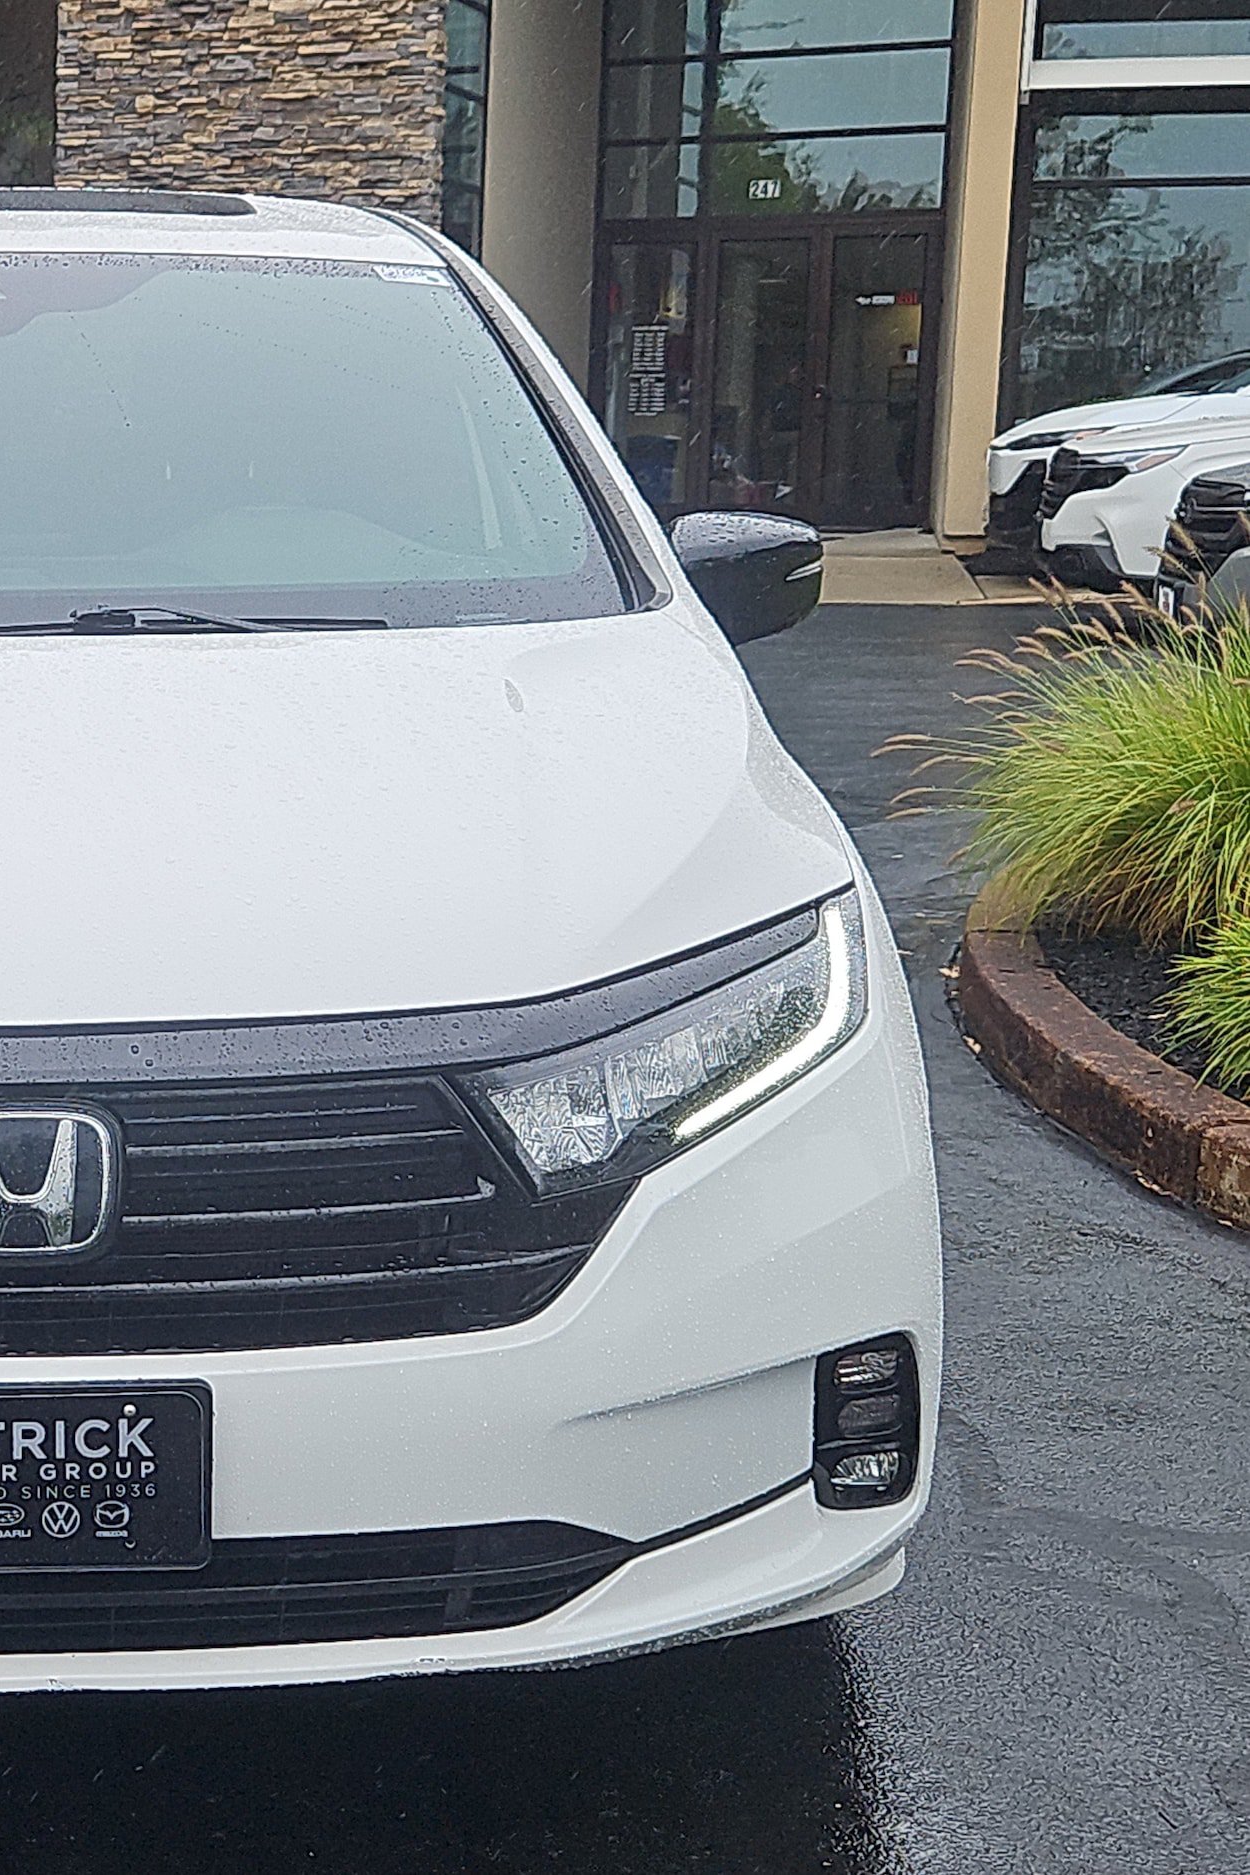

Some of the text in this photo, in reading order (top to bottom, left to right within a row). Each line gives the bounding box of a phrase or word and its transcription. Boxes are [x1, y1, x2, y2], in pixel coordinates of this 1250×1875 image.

[751, 181, 778, 198] 247
[39, 1461, 156, 1481] GROUP
[21, 1485, 91, 1500] SINCE
[104, 1483, 156, 1498] 1936
